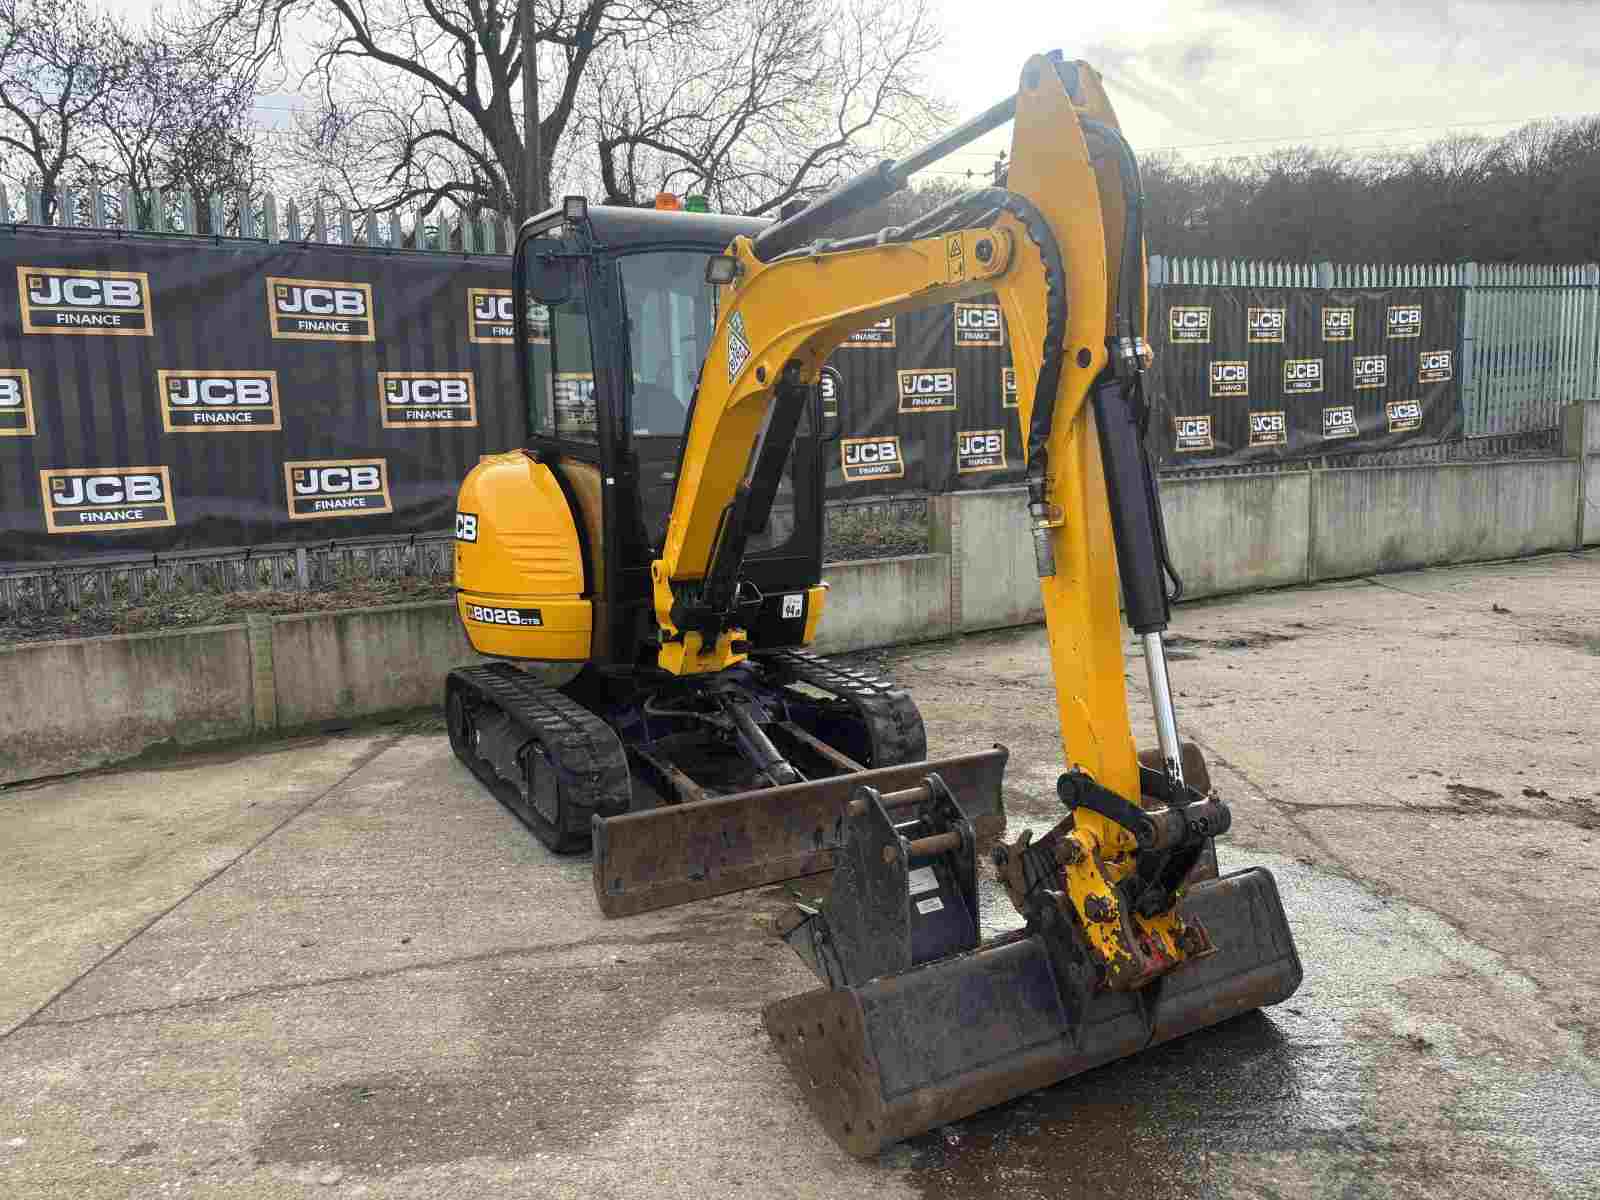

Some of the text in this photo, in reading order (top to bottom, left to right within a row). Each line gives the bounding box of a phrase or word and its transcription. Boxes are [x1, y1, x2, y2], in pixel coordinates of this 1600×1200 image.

[31, 277, 141, 306] JCB
[277, 288, 366, 315] JCB
[56, 313, 121, 326] FINANCE
[959, 309, 999, 327] JCB
[1174, 312, 1207, 327] JCB
[1250, 312, 1282, 328] JCB
[1326, 312, 1351, 326] JCB
[1389, 310, 1419, 323] JCB
[298, 319, 350, 333] FINANCE
[1356, 359, 1384, 374] JCB
[1422, 355, 1448, 369] JCB
[1215, 367, 1247, 380] JCB
[1287, 366, 1319, 379] JCB
[172, 378, 270, 405] JCB
[387, 379, 468, 403] JCB
[904, 375, 952, 394] JCB
[193, 412, 252, 424] FINANCE
[406, 409, 454, 420] FINANCE
[1326, 411, 1352, 426] JCB
[1391, 404, 1419, 418] JCB
[1179, 421, 1208, 436] JCB
[1254, 416, 1282, 431] JCB
[960, 436, 1000, 454] JCB
[847, 443, 897, 463] JCB
[294, 467, 382, 494] JCB
[54, 475, 163, 504] JCB
[314, 497, 366, 510] FINANCE
[79, 509, 144, 522] FINANCE
